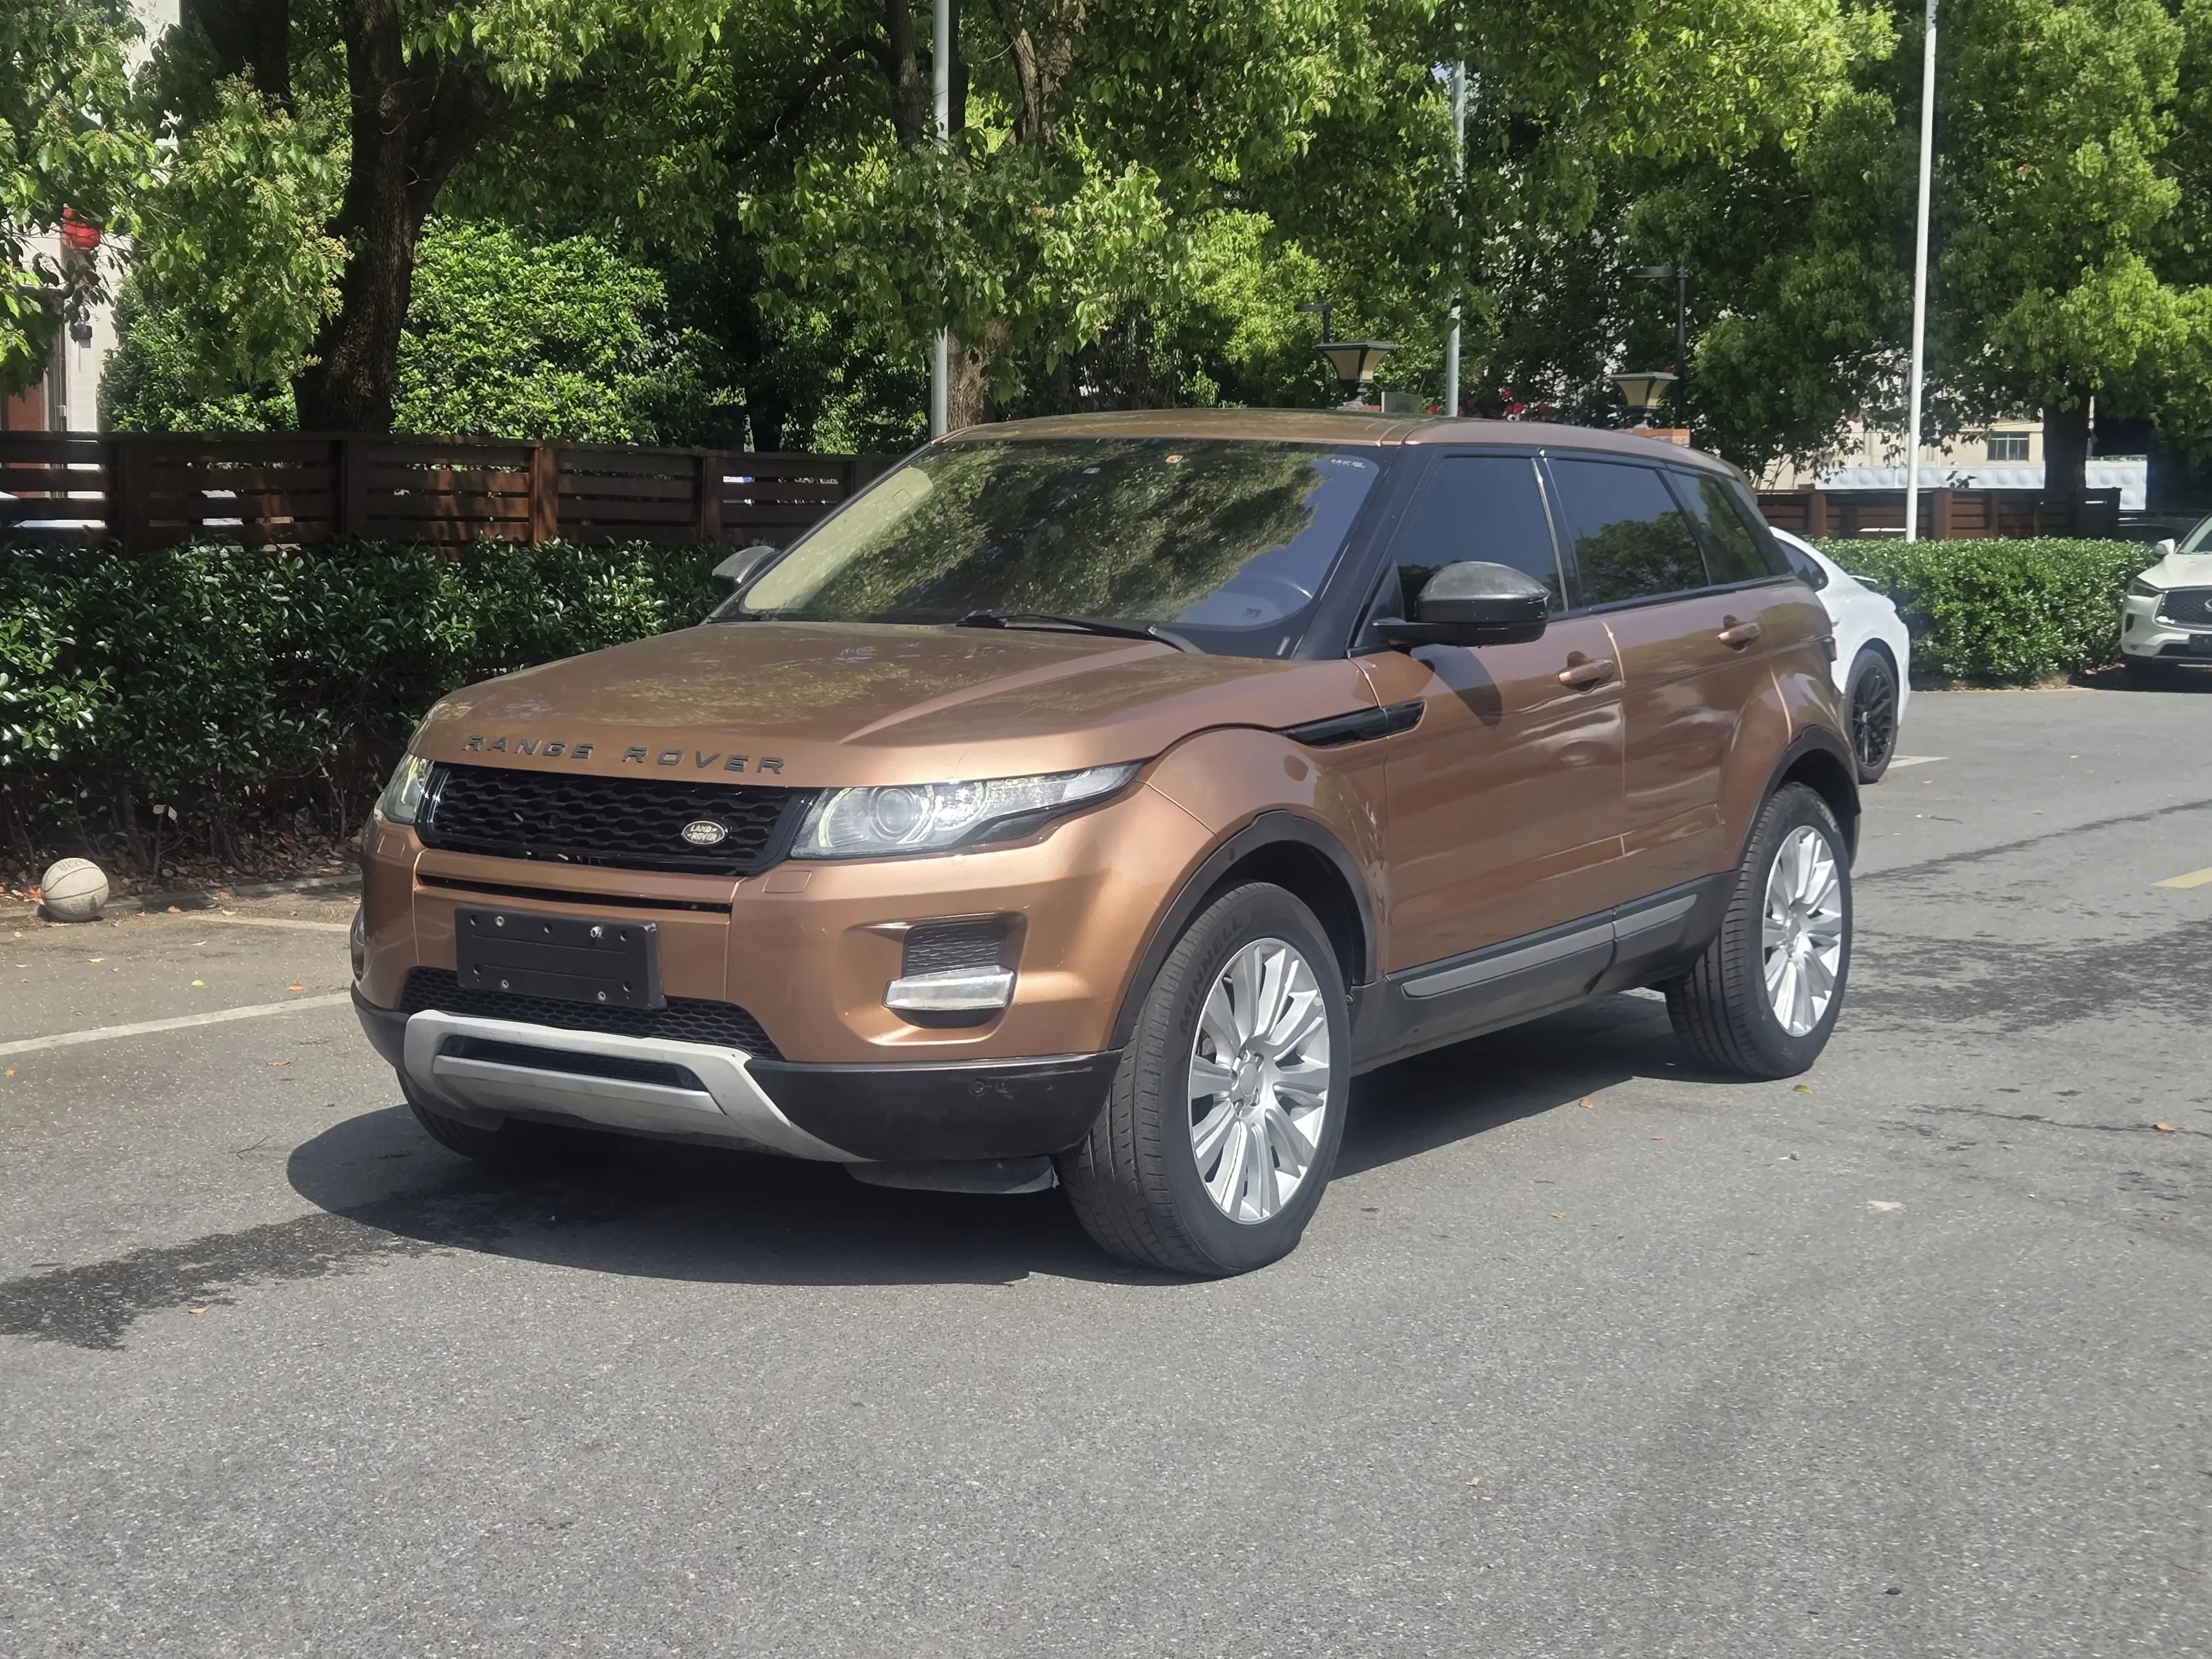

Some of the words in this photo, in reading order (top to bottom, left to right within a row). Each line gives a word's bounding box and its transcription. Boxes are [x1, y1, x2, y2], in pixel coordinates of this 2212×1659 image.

[462, 736, 594, 759] RANGE
[622, 747, 785, 774] ROVER
[690, 825, 712, 833] LAND
[691, 832, 717, 841] ROVER
